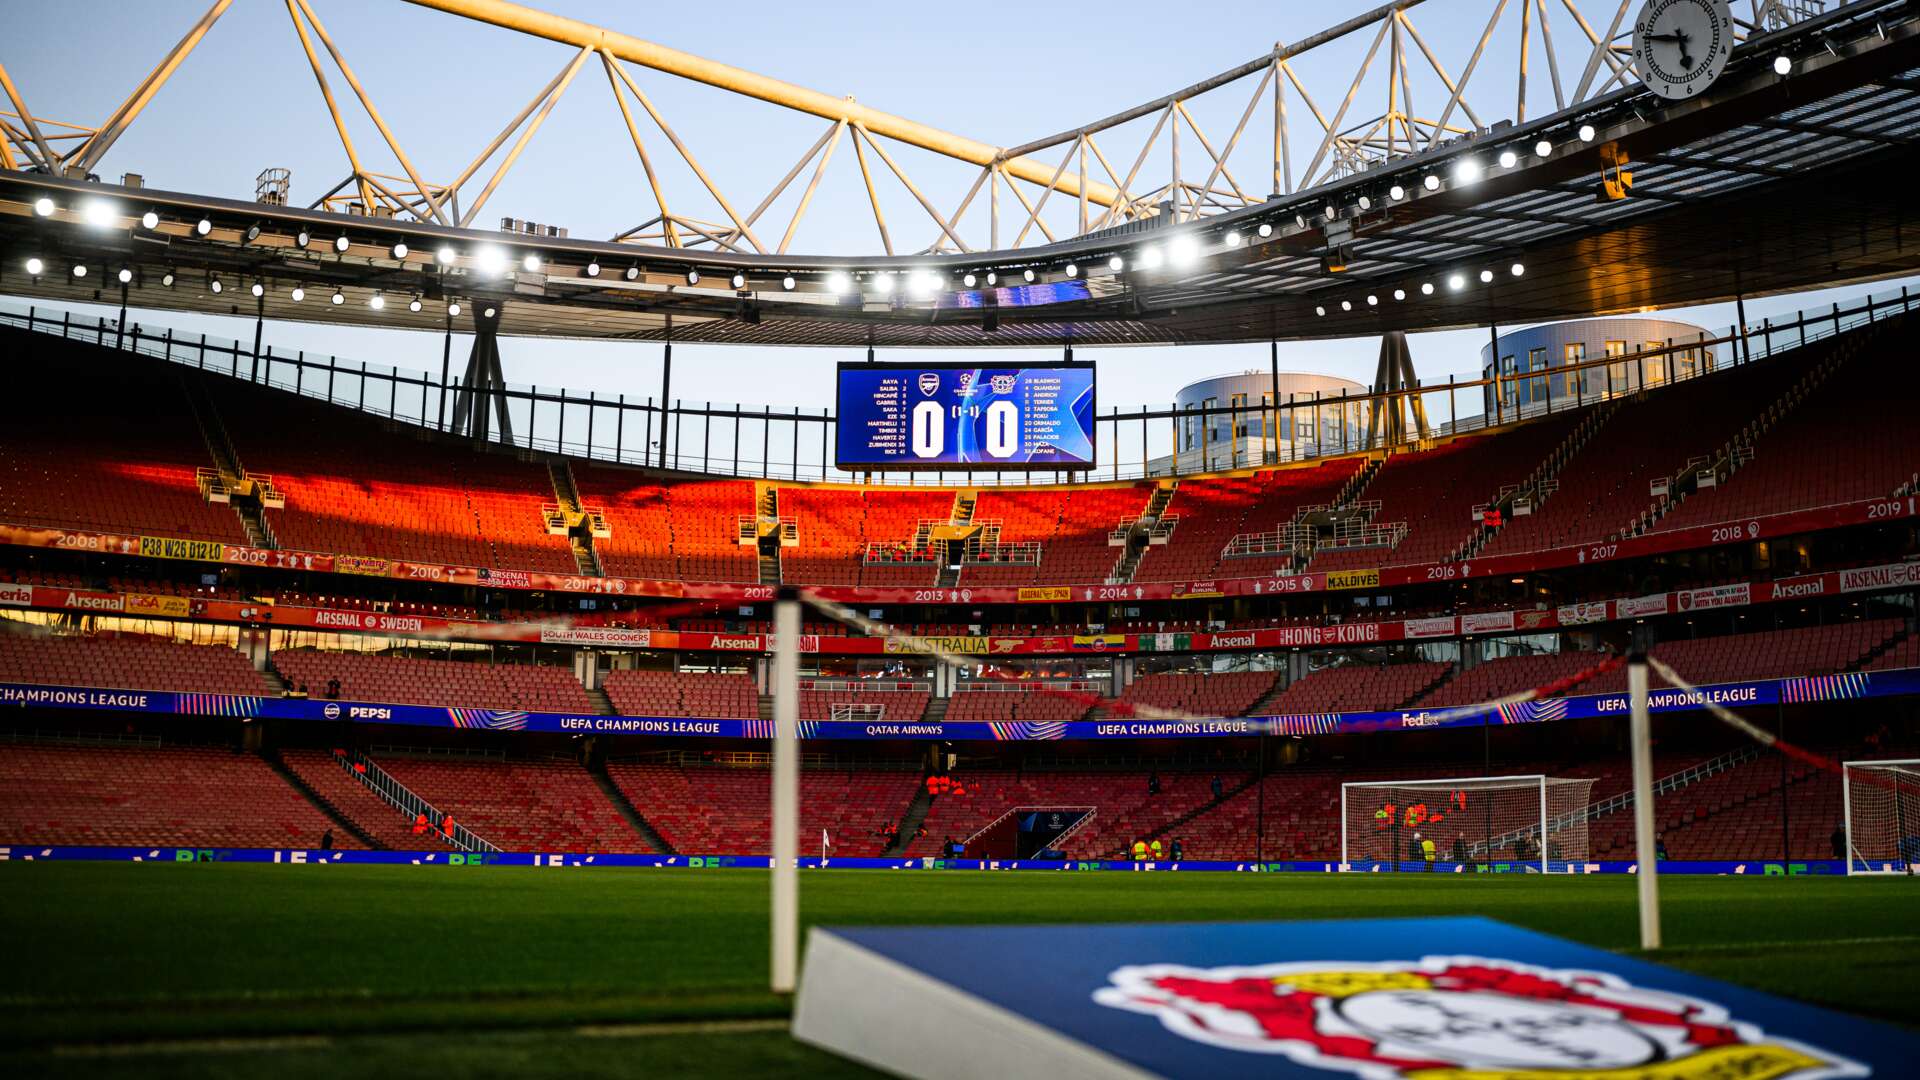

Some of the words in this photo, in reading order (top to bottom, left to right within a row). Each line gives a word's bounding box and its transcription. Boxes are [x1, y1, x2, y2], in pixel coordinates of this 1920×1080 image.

[1636, 22, 1645, 33] 10
[1722, 18, 1728, 28] 3
[1636, 50, 1642, 59] 9
[1720, 46, 1726, 54] 4
[1646, 73, 1652, 82] 8
[1708, 70, 1713, 80] 5
[1664, 85, 1669, 94] 7
[1687, 85, 1692, 94] 6
[913, 401, 944, 457] 0
[987, 401, 1018, 458] 0
[1868, 502, 1901, 518] 2019
[1712, 526, 1742, 542] 2018
[56, 534, 98, 548] 2008
[142, 538, 161, 556] P38
[165, 540, 186, 557] W26
[189, 542, 207, 559] D12
[1592, 545, 1618, 560] 2017
[230, 549, 268, 563] 2009
[410, 566, 440, 579] 2010
[491, 570, 528, 579] ARSENAL
[1427, 566, 1455, 578] 2016
[488, 578, 530, 587] MALAYSIA
[564, 578, 590, 590] 2011
[1268, 579, 1296, 591] 2015
[1328, 574, 1378, 588] MALDIVES
[1845, 569, 1892, 589] ARSENAL
[744, 588, 773, 599] 2012
[1100, 588, 1128, 599] 2014
[1772, 578, 1823, 599] Arsenal
[65, 592, 124, 610] Arsenal
[915, 590, 944, 602] 2013
[316, 612, 360, 626] ARSENAL
[380, 617, 421, 631] SWEDEN
[575, 632, 605, 640] WALES
[607, 633, 648, 641] GOONERS
[1210, 633, 1255, 647] Arsenal
[1286, 628, 1320, 644] HONG
[1337, 625, 1374, 642] KONG
[711, 636, 759, 649] Arsenal
[901, 638, 987, 652] AUSTRALIA
[90, 694, 148, 707] LEAGUE
[1597, 699, 1627, 711] UEFA
[1630, 692, 1703, 709] AMPIONS
[1707, 688, 1756, 703] LEAGUE
[350, 707, 390, 719] PEPSI
[1402, 712, 1439, 726] FedEx
[561, 718, 592, 729] UEFA
[596, 720, 670, 732] CHAMPIONS
[672, 722, 720, 733] LEAGUE
[866, 725, 899, 736] QATAR
[901, 725, 942, 735] AIRWAYS
[1097, 725, 1128, 735] UEFA
[1130, 723, 1200, 734] CHAMPIONS
[1202, 722, 1247, 733] LEAGUE
